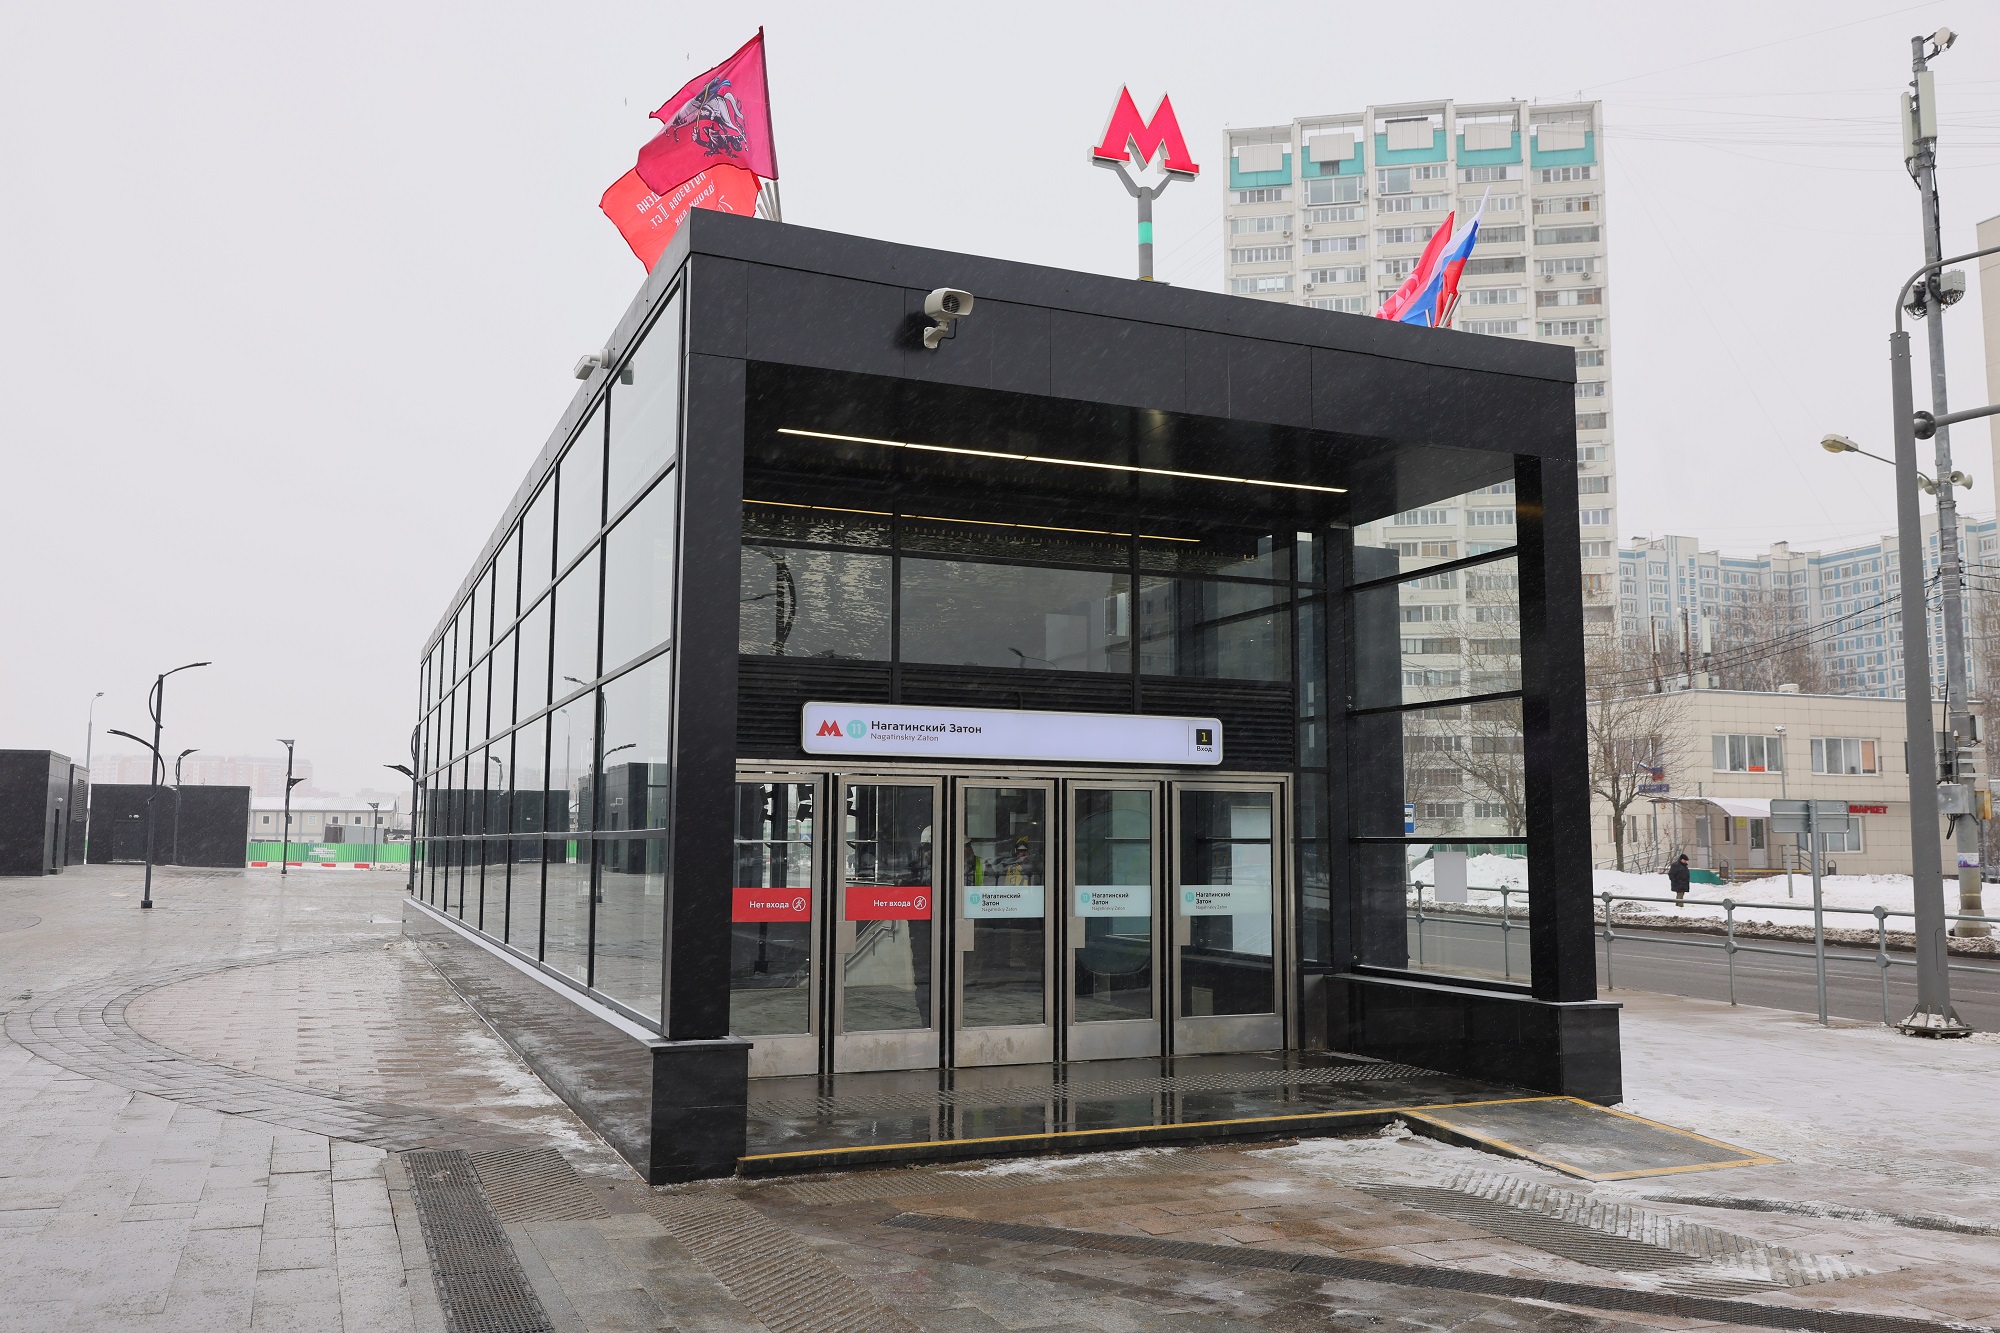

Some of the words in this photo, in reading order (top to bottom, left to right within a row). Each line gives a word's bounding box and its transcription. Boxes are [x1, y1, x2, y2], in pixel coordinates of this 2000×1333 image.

[1088, 83, 1200, 176] М
[816, 720, 843, 737] М
[851, 723, 862, 735] 11
[871, 721, 946, 733] Нагатинский
[949, 723, 982, 734] Затон
[870, 733, 916, 742] Nagatinskiy
[917, 734, 939, 742] Zaton
[1201, 732, 1208, 742] 1
[749, 901, 765, 909] Нет
[766, 902, 789, 910] входа
[889, 900, 911, 908] входа
